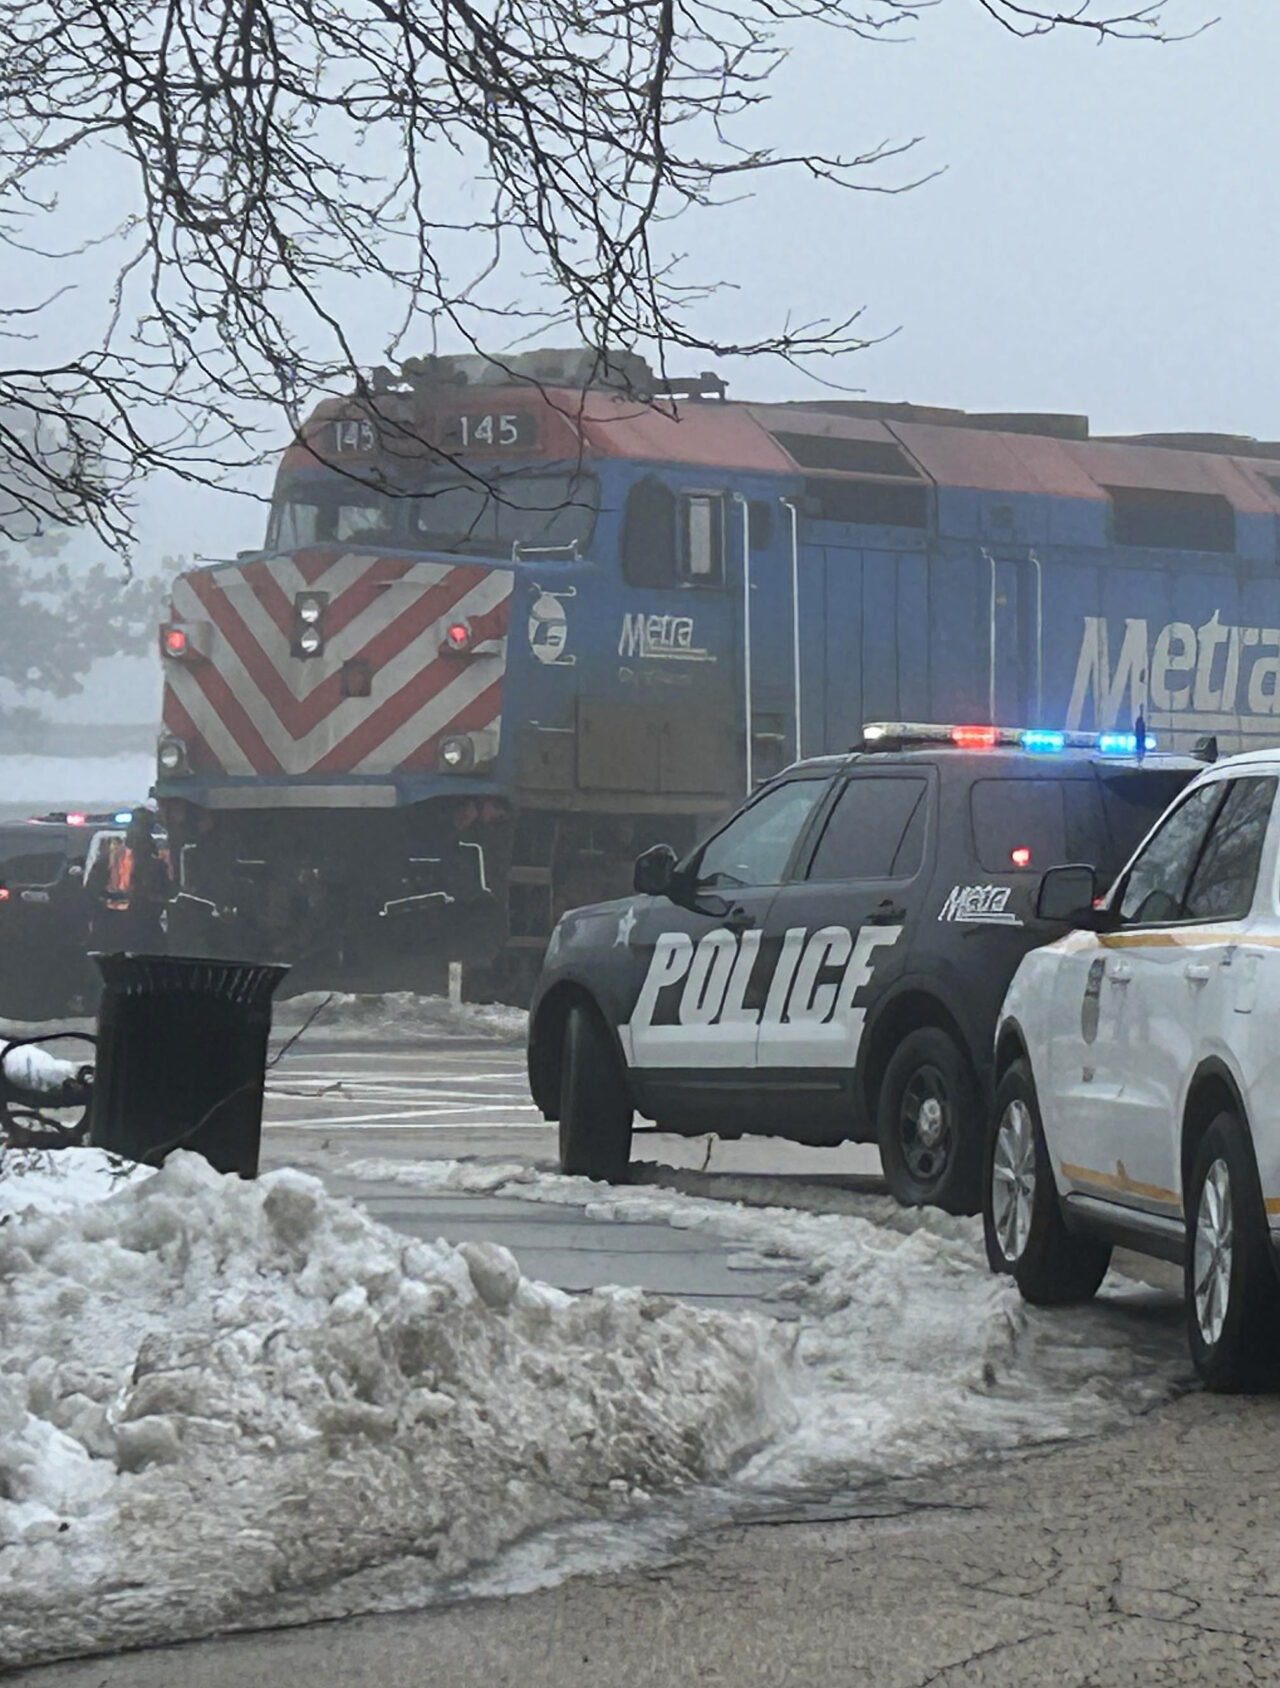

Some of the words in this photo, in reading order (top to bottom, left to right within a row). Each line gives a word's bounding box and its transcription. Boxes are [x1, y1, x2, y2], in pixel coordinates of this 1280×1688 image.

[336, 419, 375, 452] 145
[460, 415, 518, 446] 145
[618, 613, 698, 657] Metra
[937, 885, 1013, 921] Metra
[630, 925, 903, 1026] POLICE
